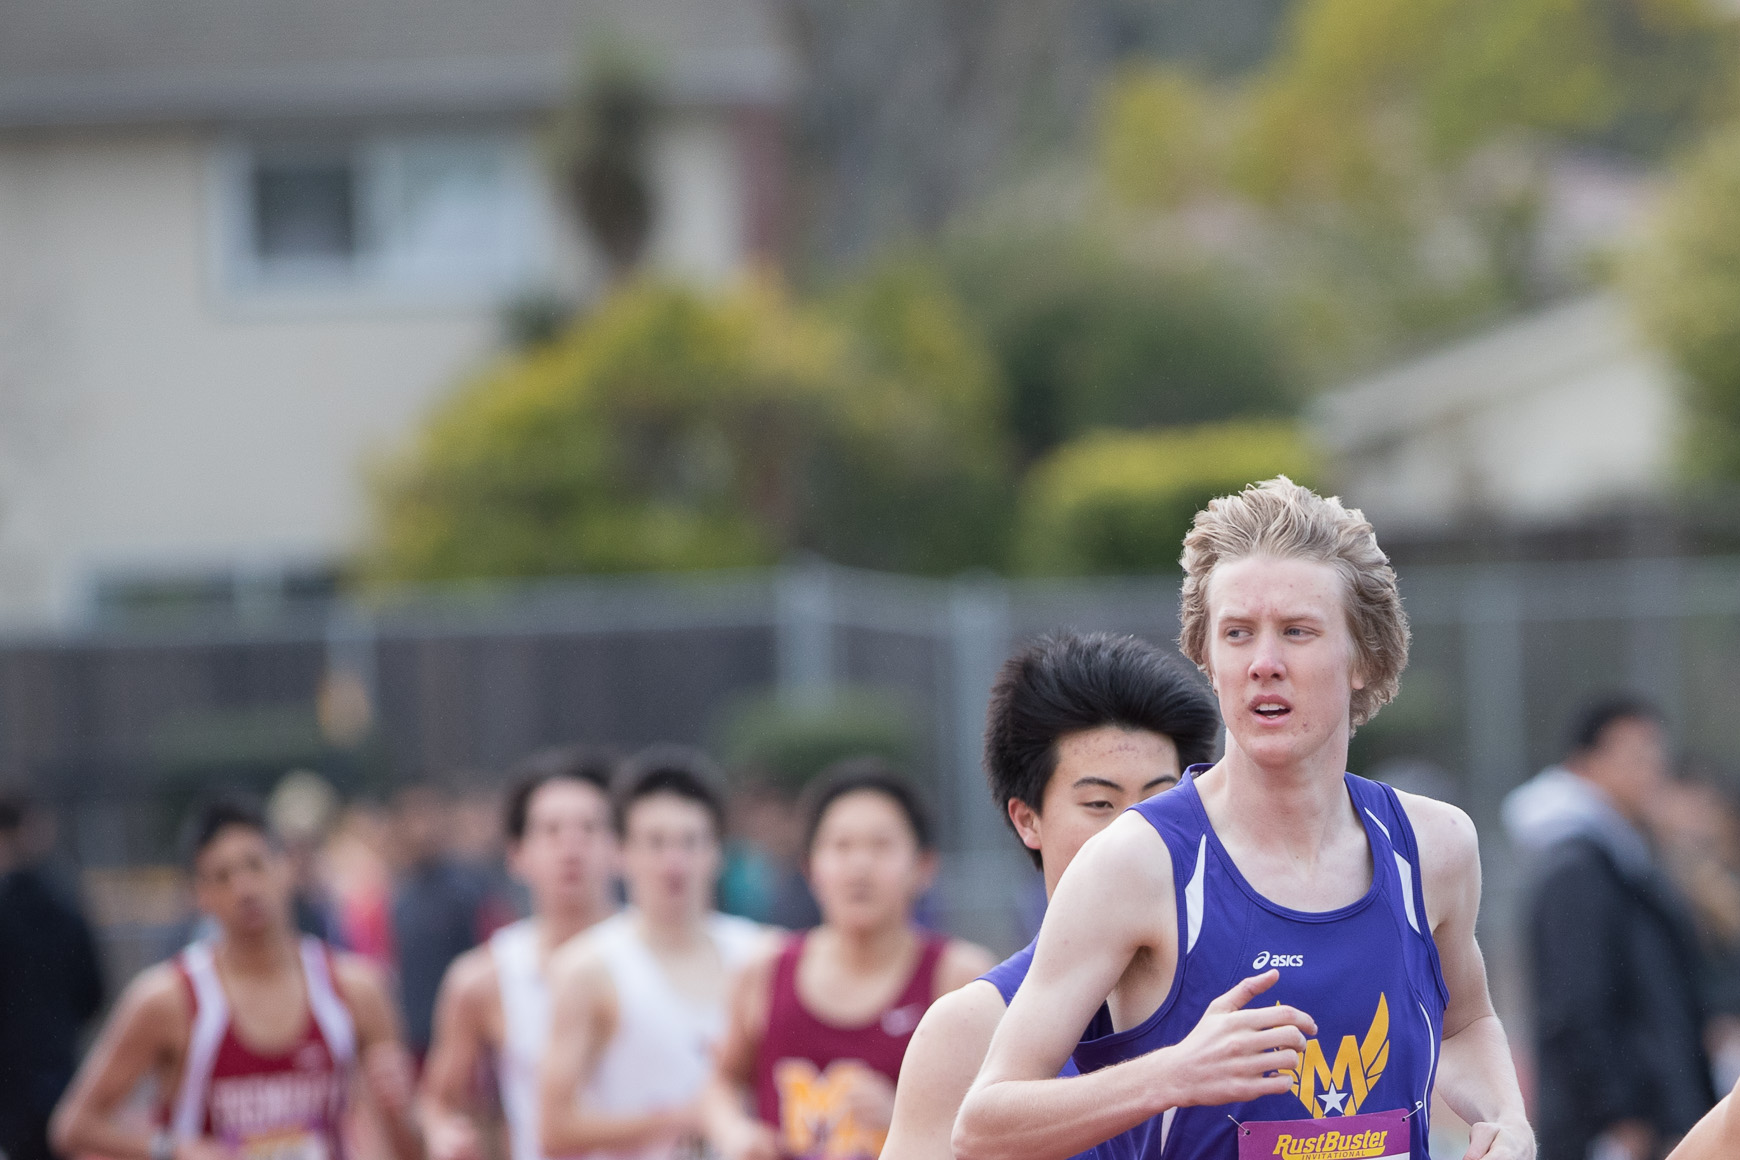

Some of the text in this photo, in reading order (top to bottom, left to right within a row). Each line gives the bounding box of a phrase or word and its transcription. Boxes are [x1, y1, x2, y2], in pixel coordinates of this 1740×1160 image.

[1270, 954, 1304, 967] asics
[1272, 1129, 1389, 1155] RustBuster
[1301, 1150, 1367, 1160] INVITATIONAL
